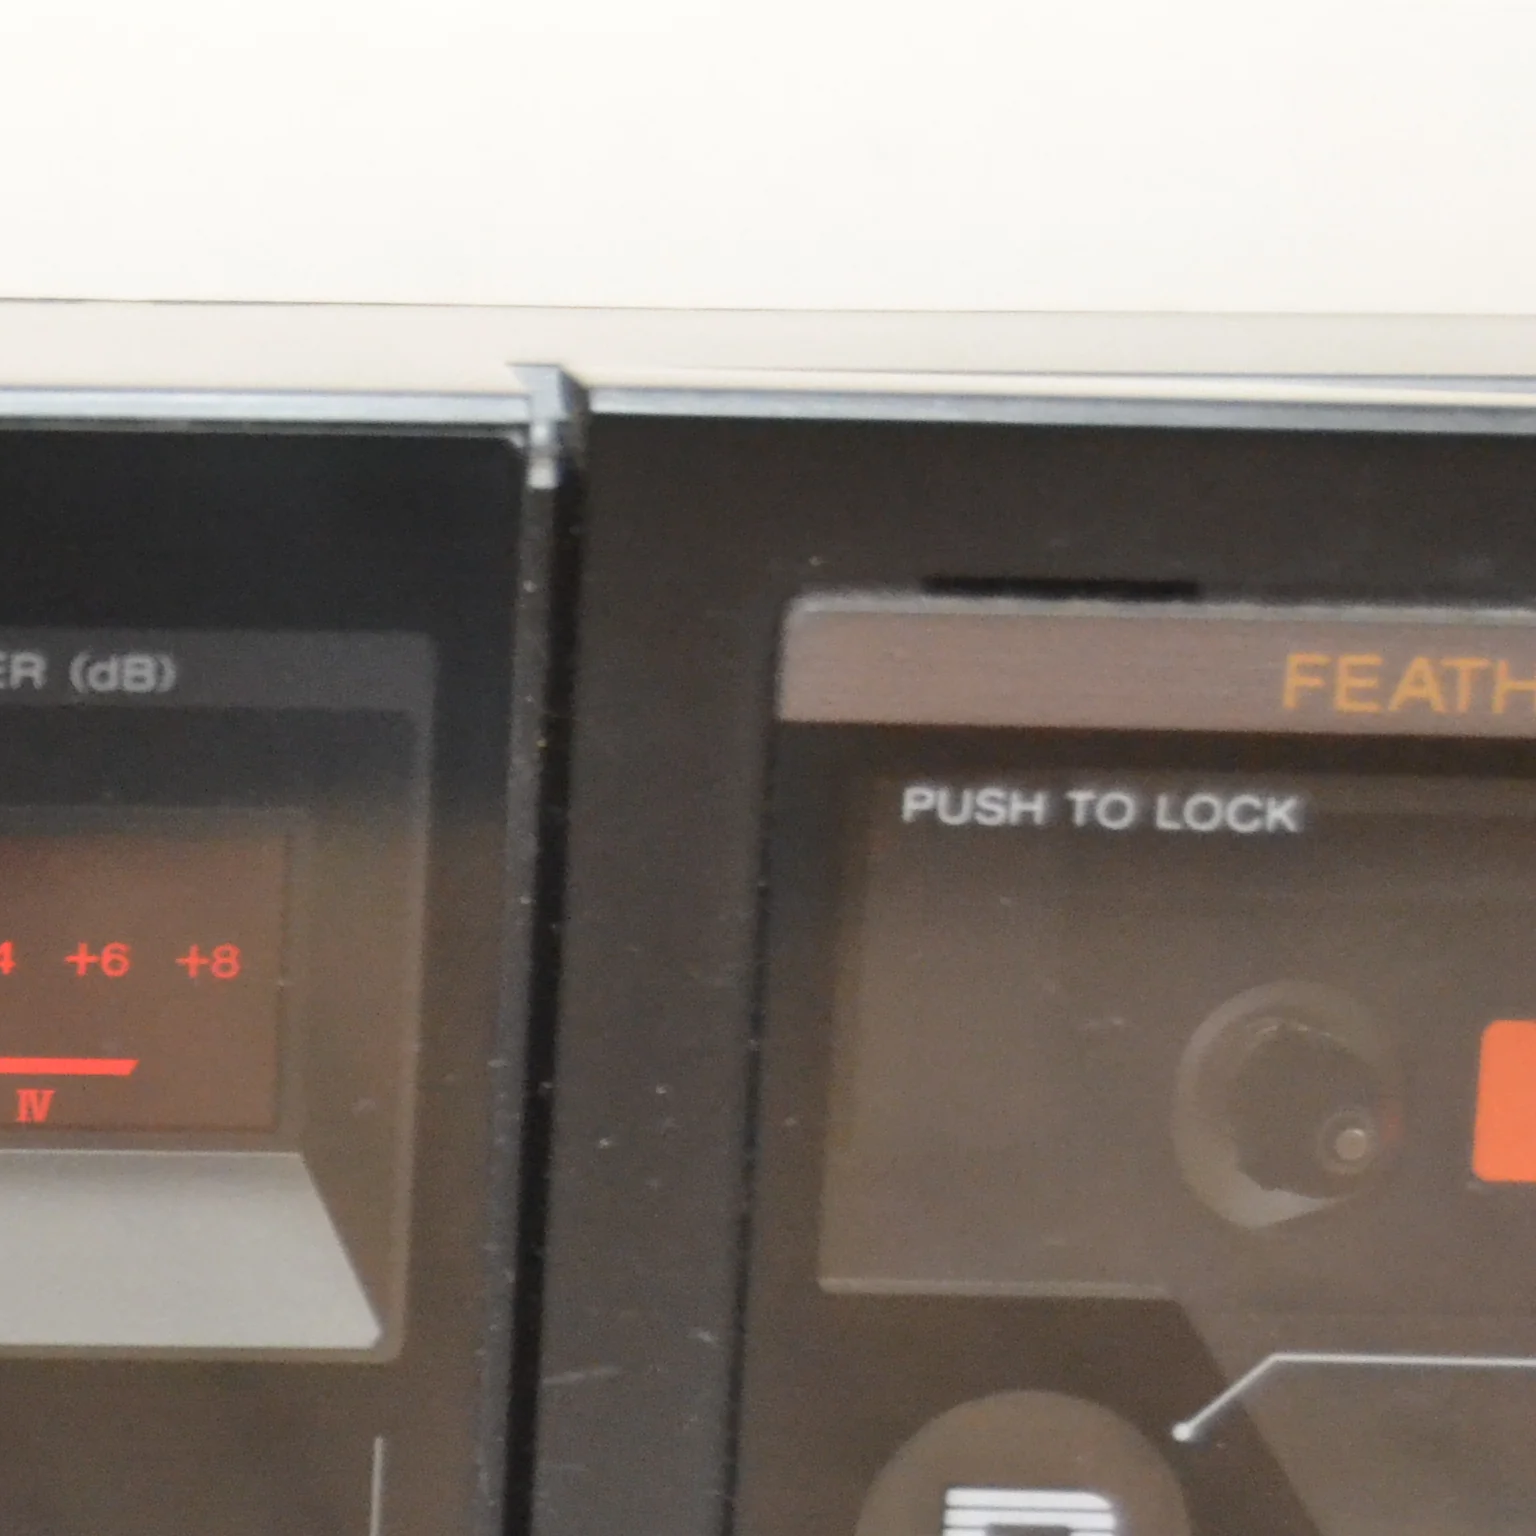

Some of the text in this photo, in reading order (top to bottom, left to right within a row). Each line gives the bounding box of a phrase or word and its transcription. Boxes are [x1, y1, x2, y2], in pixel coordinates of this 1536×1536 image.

[68, 651, 177, 692] (dB)
[1281, 652, 1536, 714] FEATH
[902, 786, 1302, 834] PUSH TO LOCK
[65, 942, 130, 977] +6
[176, 943, 242, 979] +8
